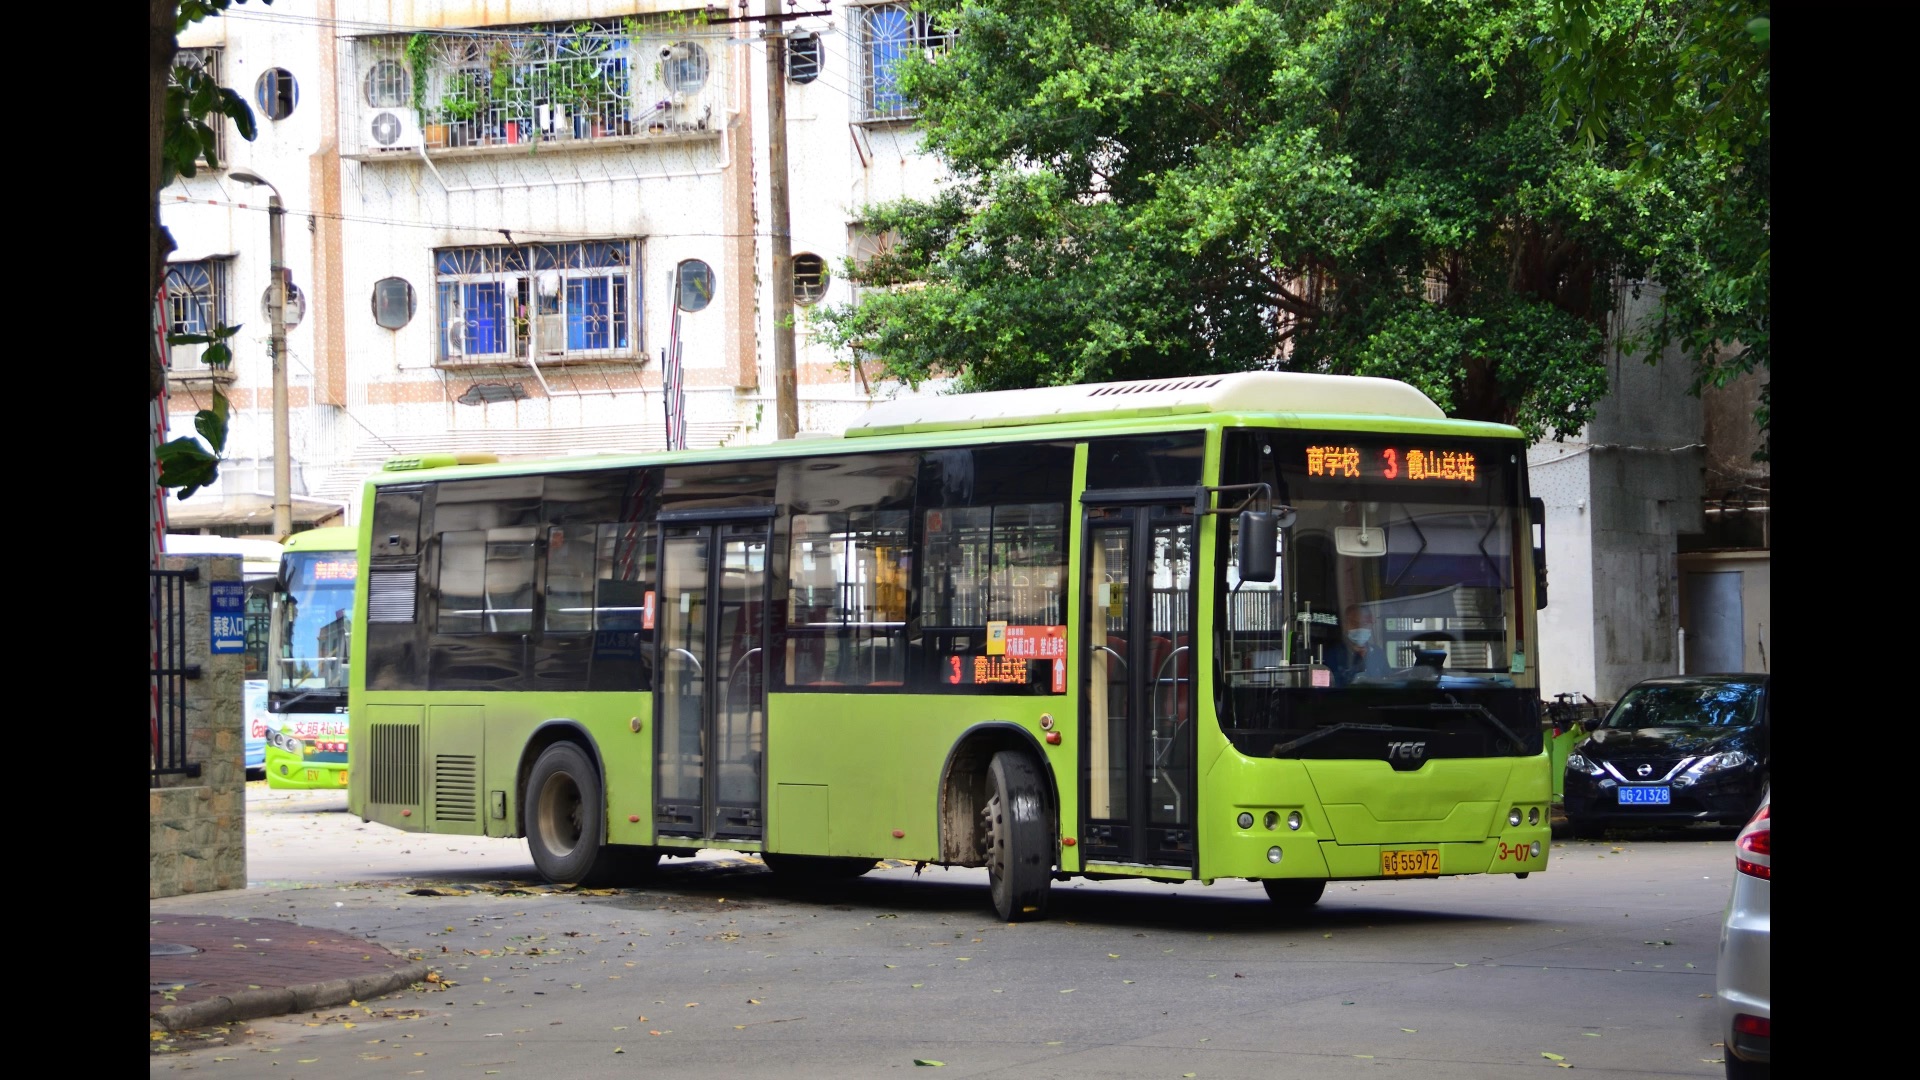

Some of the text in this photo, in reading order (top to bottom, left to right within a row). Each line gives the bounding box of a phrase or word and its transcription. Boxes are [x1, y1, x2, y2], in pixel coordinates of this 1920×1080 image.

[1306, 446, 1475, 482] 商学校 3 霞山总站
[213, 616, 244, 637] 乘客入口
[949, 655, 1027, 685] 3 霞山总站
[294, 721, 345, 735] 文明礼让
[1388, 741, 1426, 759] TEG
[307, 769, 320, 781] EV
[1498, 842, 1531, 862] 3-07
